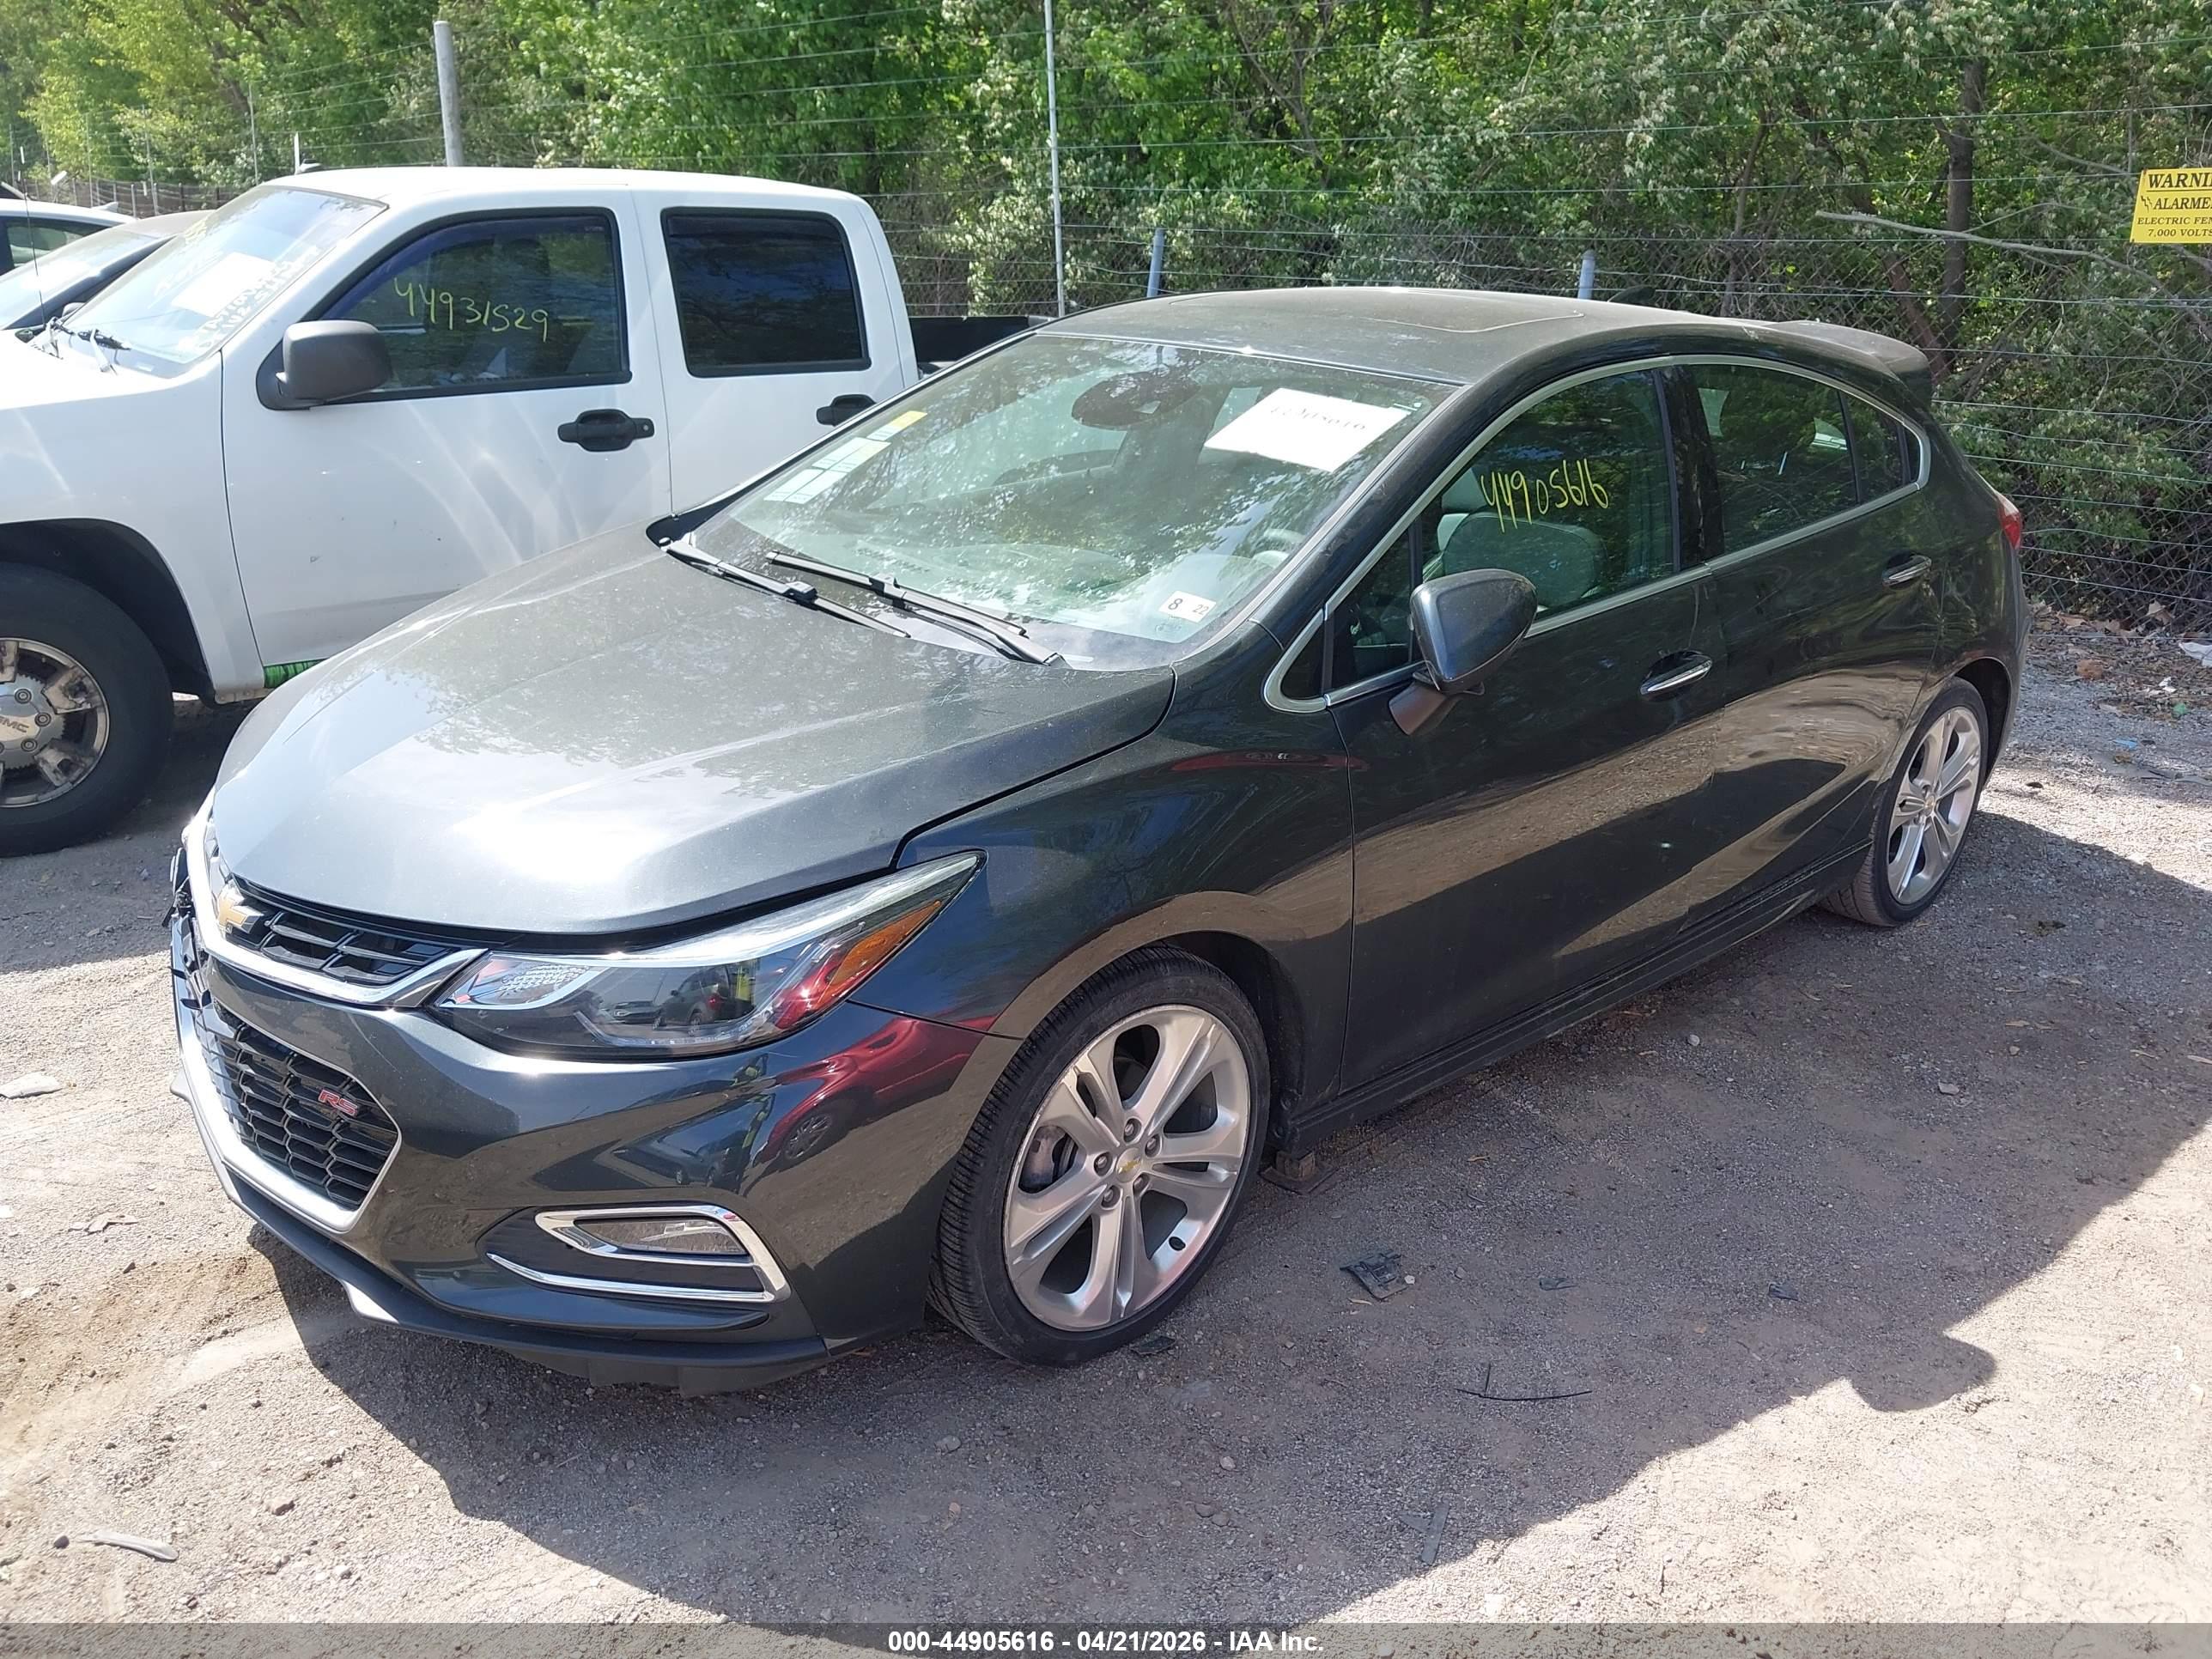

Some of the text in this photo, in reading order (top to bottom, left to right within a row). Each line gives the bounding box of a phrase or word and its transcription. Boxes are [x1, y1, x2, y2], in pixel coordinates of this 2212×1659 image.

[2148, 172, 2212, 188] WARNI
[2154, 197, 2212, 210] ALARME
[2137, 216, 2191, 225] ELECTRIC
[2148, 228, 2177, 238] 7,000
[394, 276, 549, 343] 44931529
[1480, 458, 1609, 533] 44905616
[1168, 598, 1183, 611] 8
[0, 715, 29, 732] MC
[318, 1089, 358, 1116] RS
